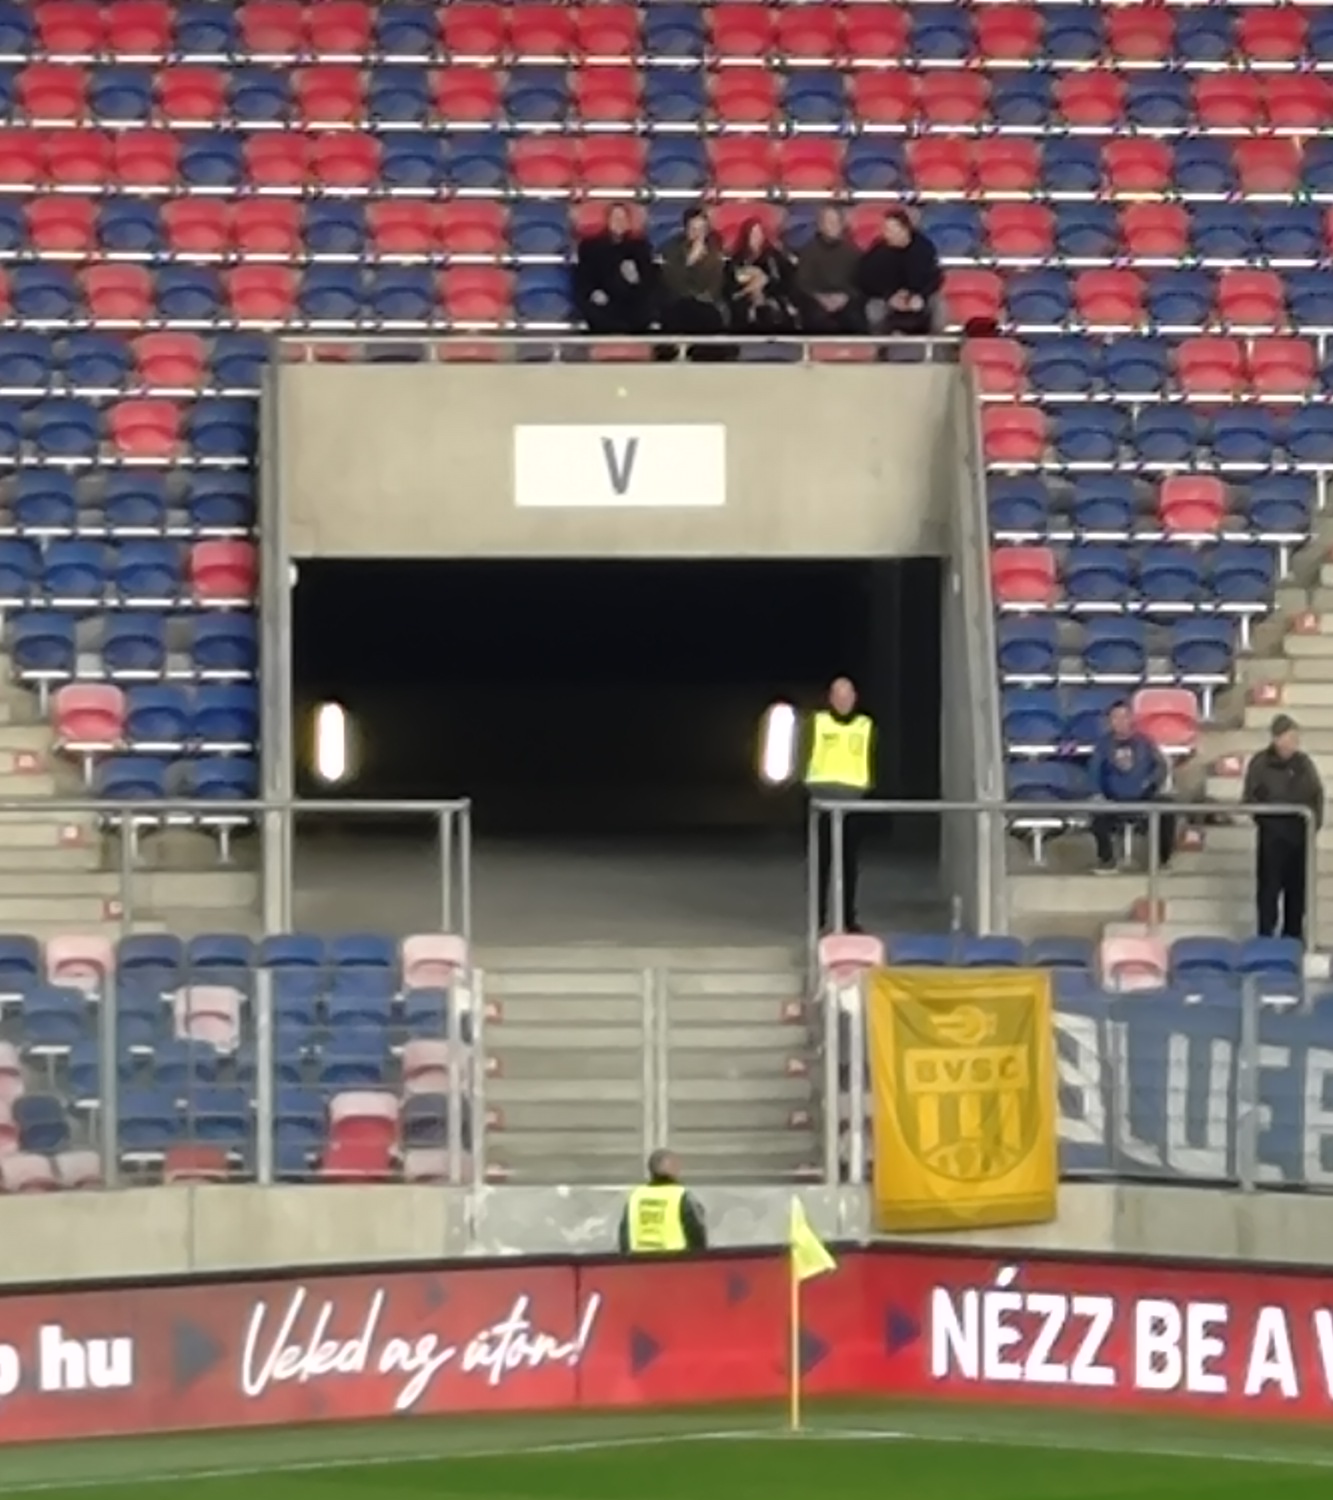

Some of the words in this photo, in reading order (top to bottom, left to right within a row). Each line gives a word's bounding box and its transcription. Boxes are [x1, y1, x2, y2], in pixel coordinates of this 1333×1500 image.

[600, 435, 640, 496] V
[914, 1055, 1020, 1084] BVSC
[1052, 1010, 1290, 1182] BLUE
[39, 1324, 133, 1391] hu
[242, 1286, 382, 1396] Veled
[930, 1266, 1116, 1386] NÉZZ
[1134, 1299, 1229, 1393] BE
[1243, 1306, 1300, 1398] A
